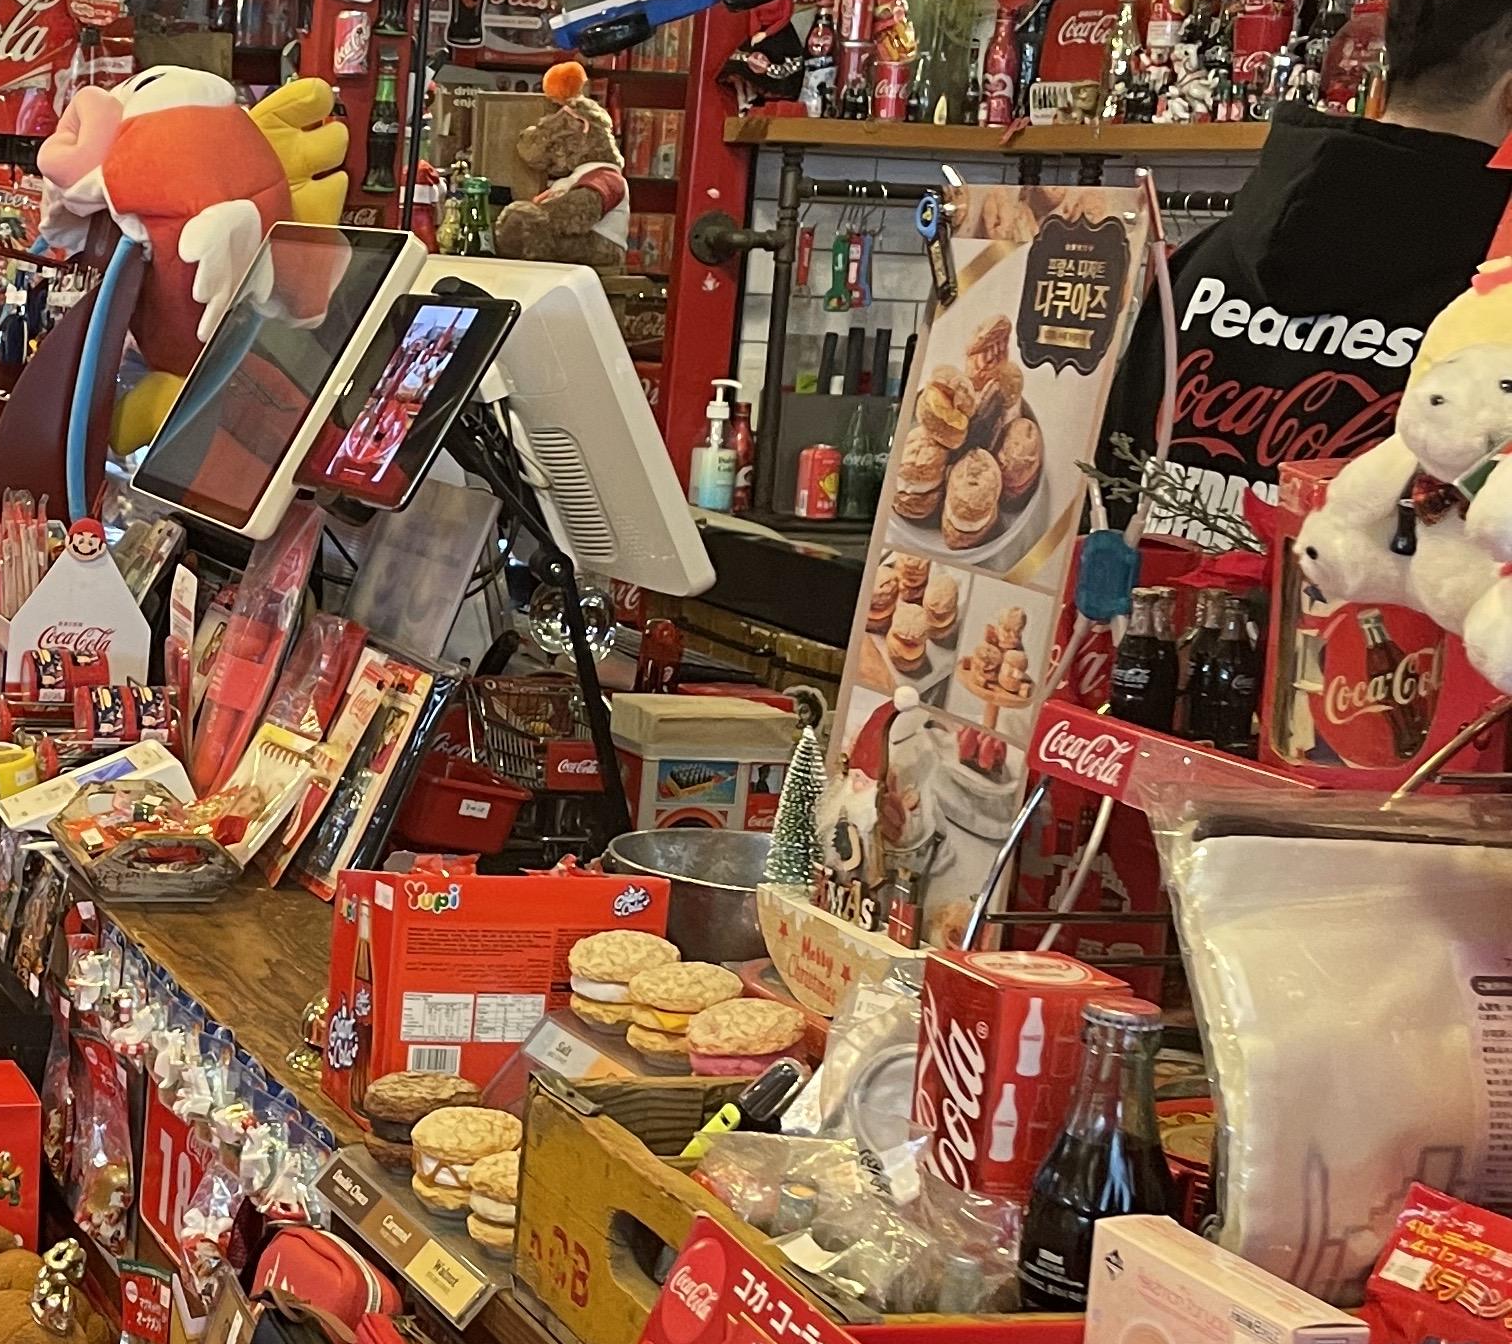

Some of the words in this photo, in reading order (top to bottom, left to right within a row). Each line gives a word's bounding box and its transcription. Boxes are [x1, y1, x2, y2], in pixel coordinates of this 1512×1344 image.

[1034, 280, 1111, 322] 다쿠아즈
[1155, 348, 1403, 468] Coca-Col
[38, 625, 116, 654] Coca-Cola
[556, 759, 600, 777] Coca-Cola
[1039, 720, 1135, 788] Coca-Cola
[404, 880, 461, 914] Yupi
[788, 954, 837, 1006] Christmas
[381, 1213, 412, 1244] Caramel
[433, 1258, 459, 1288] Walnut
[669, 1265, 720, 1323] Coca-Cola
